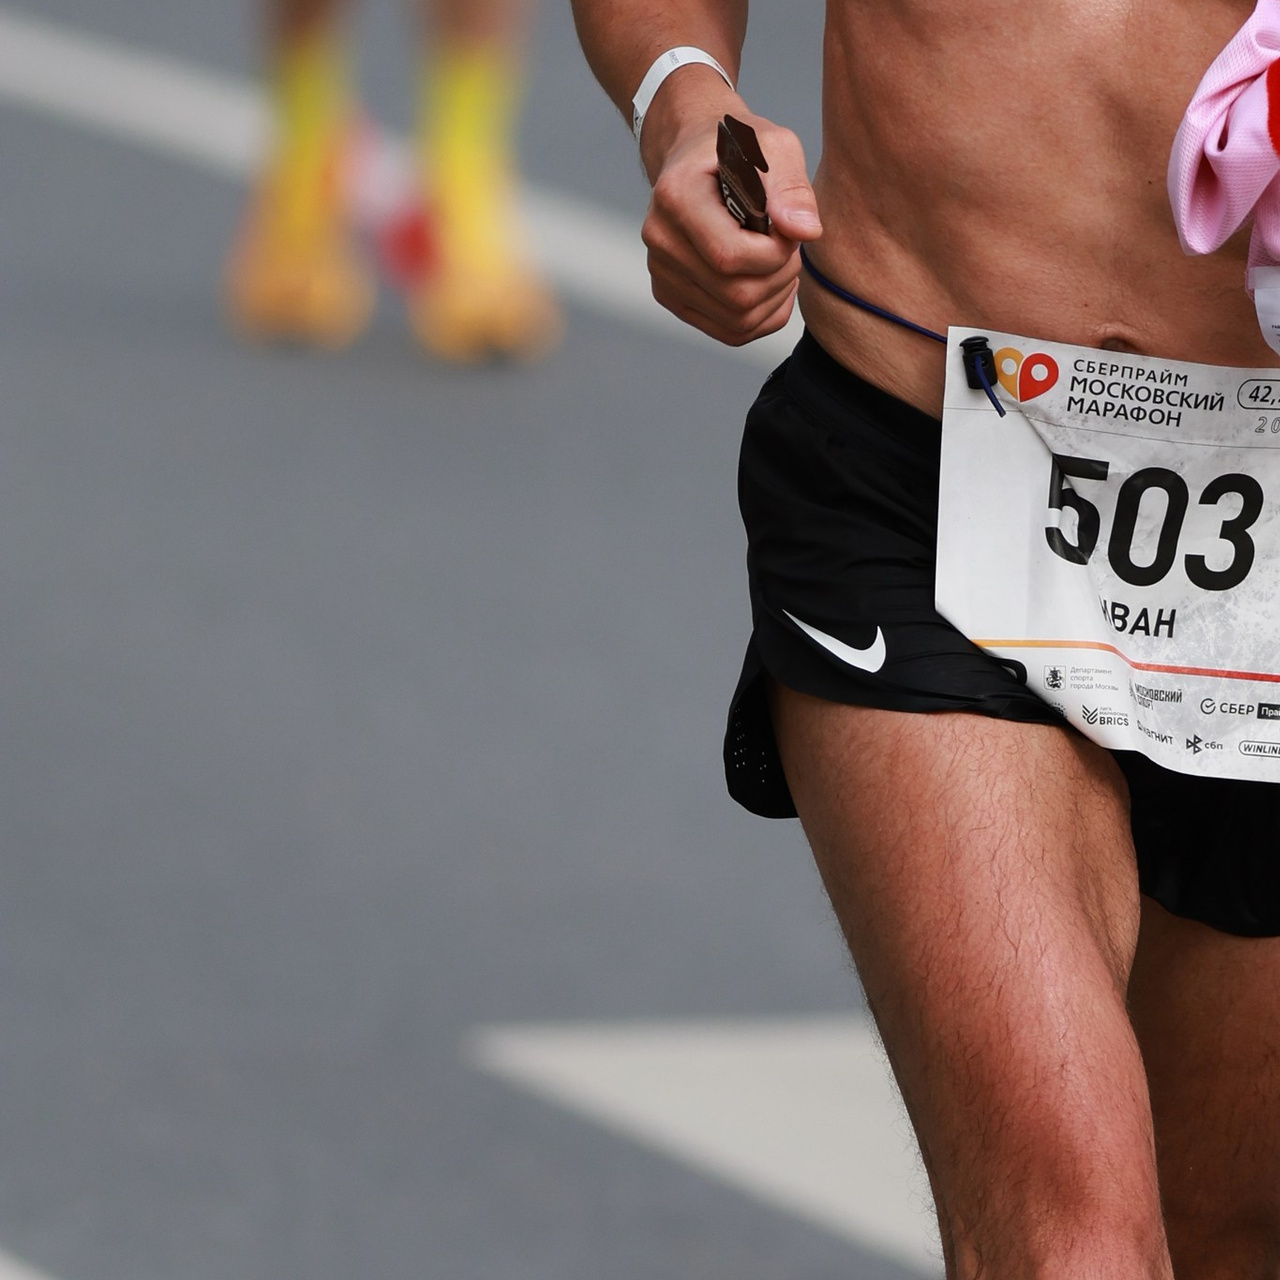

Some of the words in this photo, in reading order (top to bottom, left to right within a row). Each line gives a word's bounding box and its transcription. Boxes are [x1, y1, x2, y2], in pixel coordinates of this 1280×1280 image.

[1073, 359, 1189, 387] СБЕРПРАЙМ
[1070, 376, 1225, 411] МОСКОВСКИЙ
[1066, 396, 1182, 427] МАРАФОН
[1044, 452, 1265, 592] 503
[1099, 716, 1129, 726] BRICS
[1219, 702, 1255, 716] СБЕР
